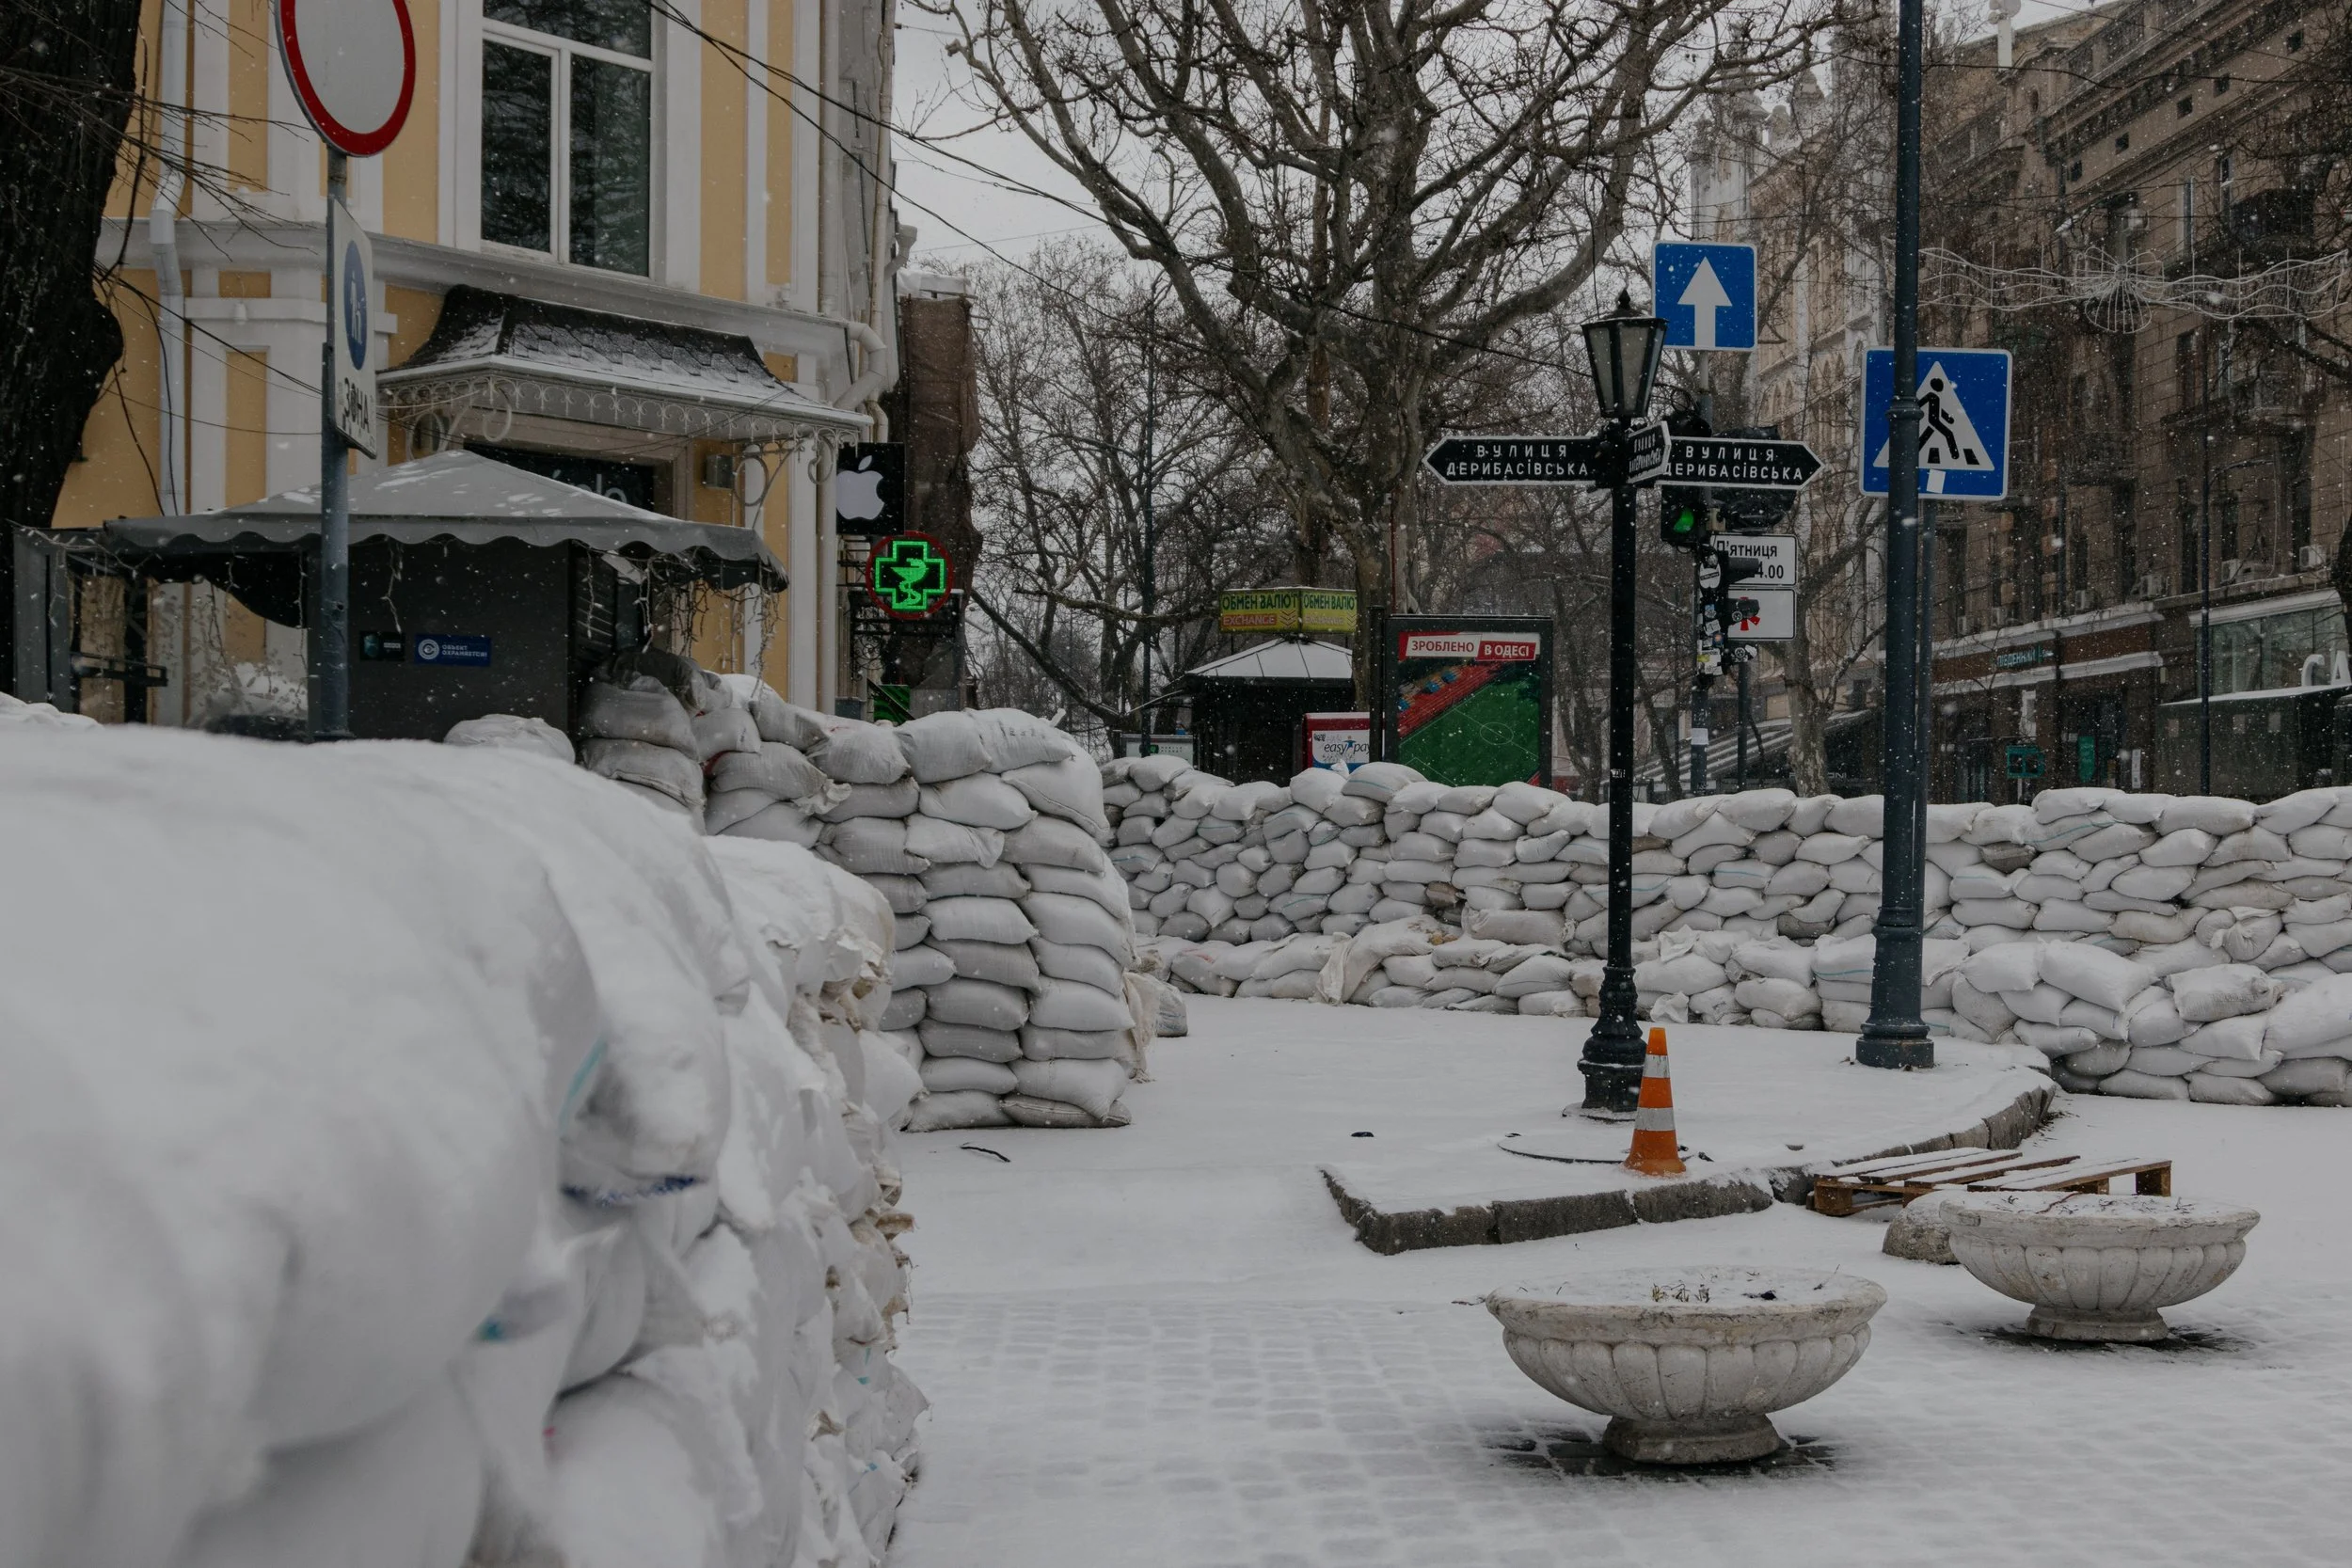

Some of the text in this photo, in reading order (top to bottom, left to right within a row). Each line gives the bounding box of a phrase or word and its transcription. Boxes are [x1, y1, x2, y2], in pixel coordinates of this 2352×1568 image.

[344, 377, 370, 434] ЗОНА
[1477, 444, 1566, 458] ВУЛИЦЯ
[1685, 445, 1774, 462] ВУЛИЦЯ
[1223, 593, 1297, 610] ОБМЕН ВАЛЮТ
[1303, 594, 1329, 610] ОБМЕН
[1224, 615, 1276, 626] EXCHANGE
[1411, 640, 1530, 658] ЗРОБЛЕНО В ОДЕСІ
[1324, 743, 1348, 755] easy
